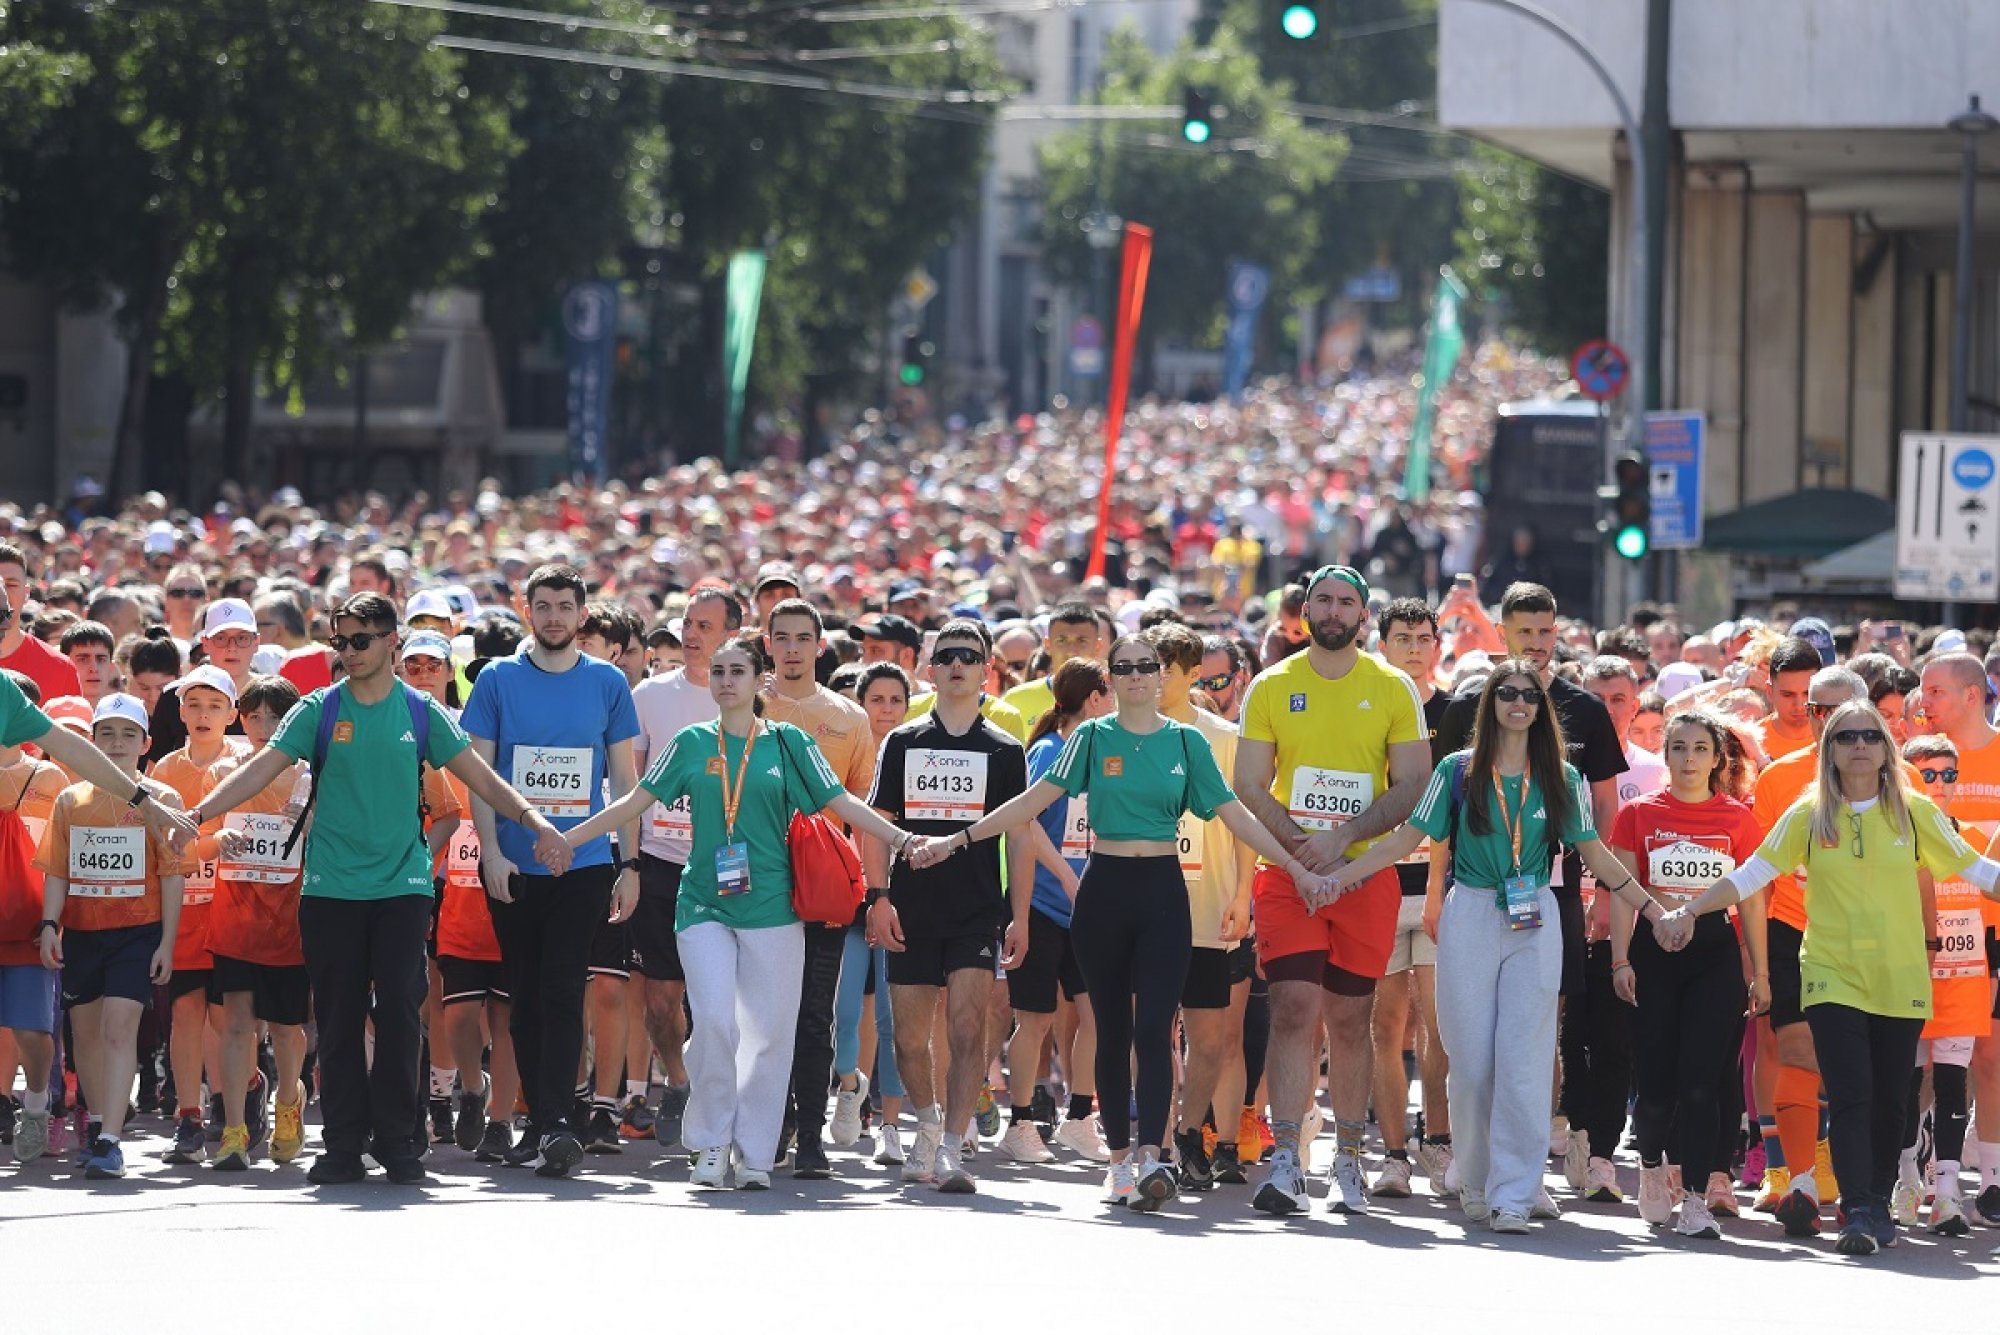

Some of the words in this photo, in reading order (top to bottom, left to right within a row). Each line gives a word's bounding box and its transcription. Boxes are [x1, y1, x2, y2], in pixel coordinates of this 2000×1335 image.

[525, 771, 581, 789] 64675
[917, 774, 973, 792] 64133
[1304, 792, 1362, 814] 63306
[80, 852, 133, 870] 64620
[1661, 860, 1722, 878] 63035
